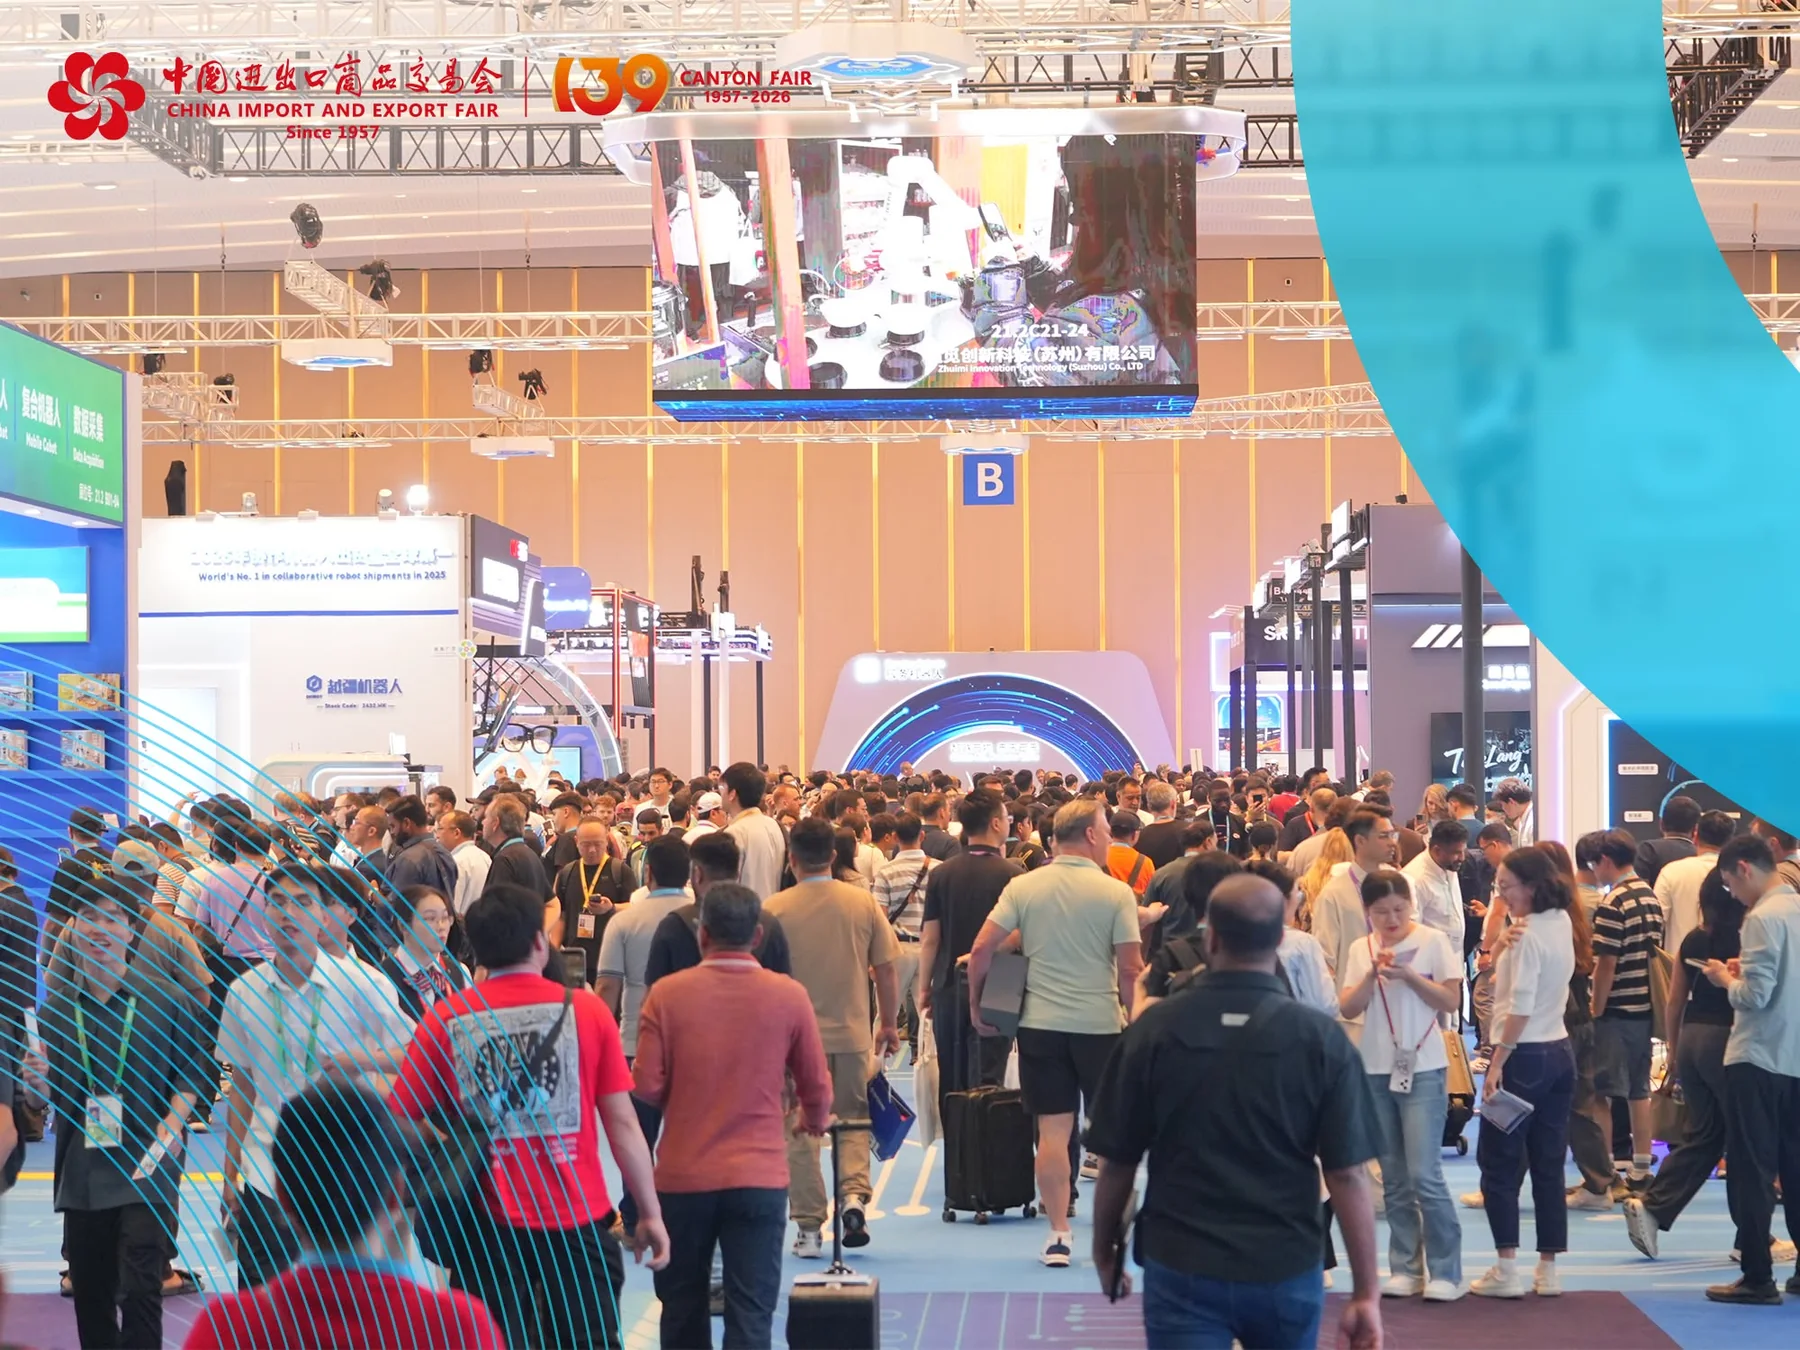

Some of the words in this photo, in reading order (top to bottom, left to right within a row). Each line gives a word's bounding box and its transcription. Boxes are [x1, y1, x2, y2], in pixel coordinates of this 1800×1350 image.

[991, 323, 1089, 338] 21.2C21-24
[938, 364, 969, 373] Zhuimi
[970, 364, 1017, 373] Innovation
[1127, 361, 1144, 371] LTD
[21, 385, 62, 429] 复合机器人
[26, 431, 42, 451] Mobile
[43, 437, 58, 455] Cobot
[977, 462, 1004, 497] B
[198, 572, 234, 582] World's
[236, 572, 252, 581] No.
[254, 572, 259, 581] 1
[262, 571, 270, 581] in
[272, 571, 333, 581] collaborative
[336, 571, 361, 581] robot
[363, 571, 411, 583] shipments
[413, 571, 422, 580] in
[424, 570, 447, 580] 2025
